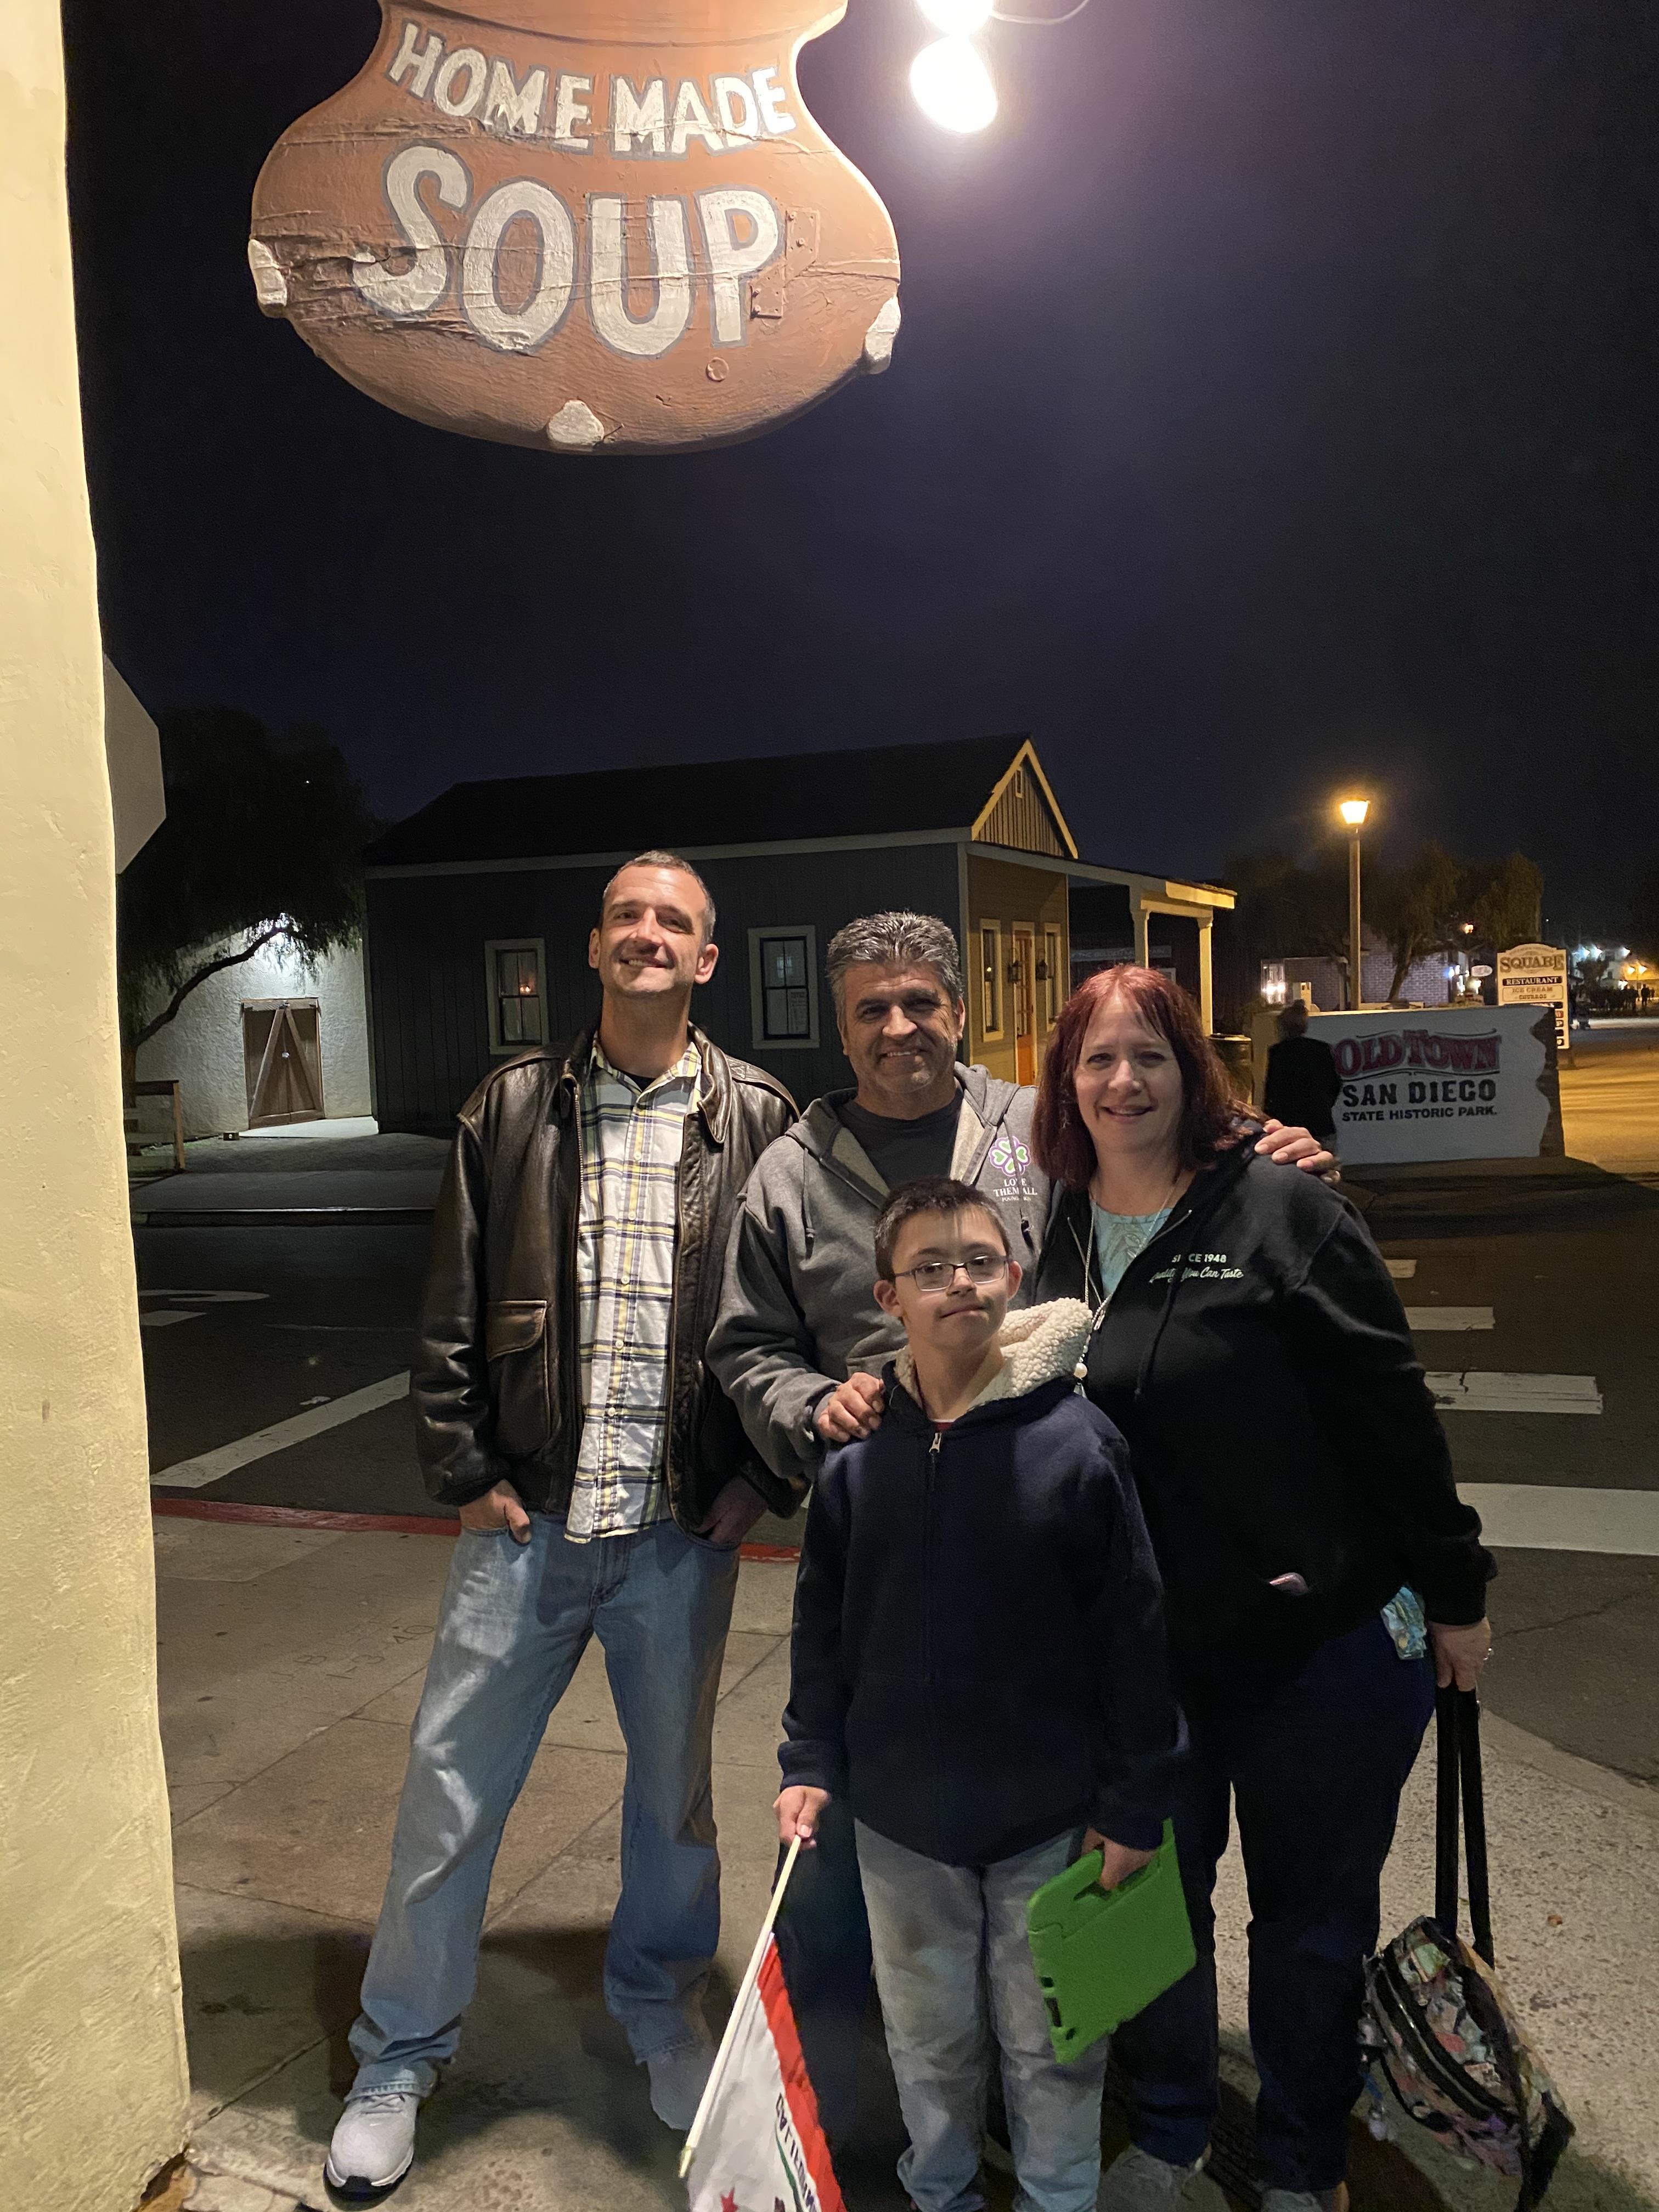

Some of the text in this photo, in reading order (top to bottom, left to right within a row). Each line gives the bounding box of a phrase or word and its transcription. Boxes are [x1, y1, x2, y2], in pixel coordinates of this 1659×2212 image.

[388, 22, 797, 156] HOME MADE
[351, 145, 781, 357] SOUP
[1500, 953, 1565, 973] SQUARE
[1506, 977, 1559, 986] RESTAURANT
[1334, 1029, 1502, 1077] OLD TOWN
[1342, 1079, 1497, 1107] SAN DIEGO
[1342, 1110, 1385, 1122] STATE
[1389, 1107, 1454, 1120] HISTORIC
[1003, 1178, 1027, 1187] LOE
[992, 1187, 1038, 1197] THEM ALL
[1171, 1253, 1227, 1263] SICE 1948
[1200, 1266, 1220, 1279] Can
[1220, 1267, 1244, 1280] Taste
